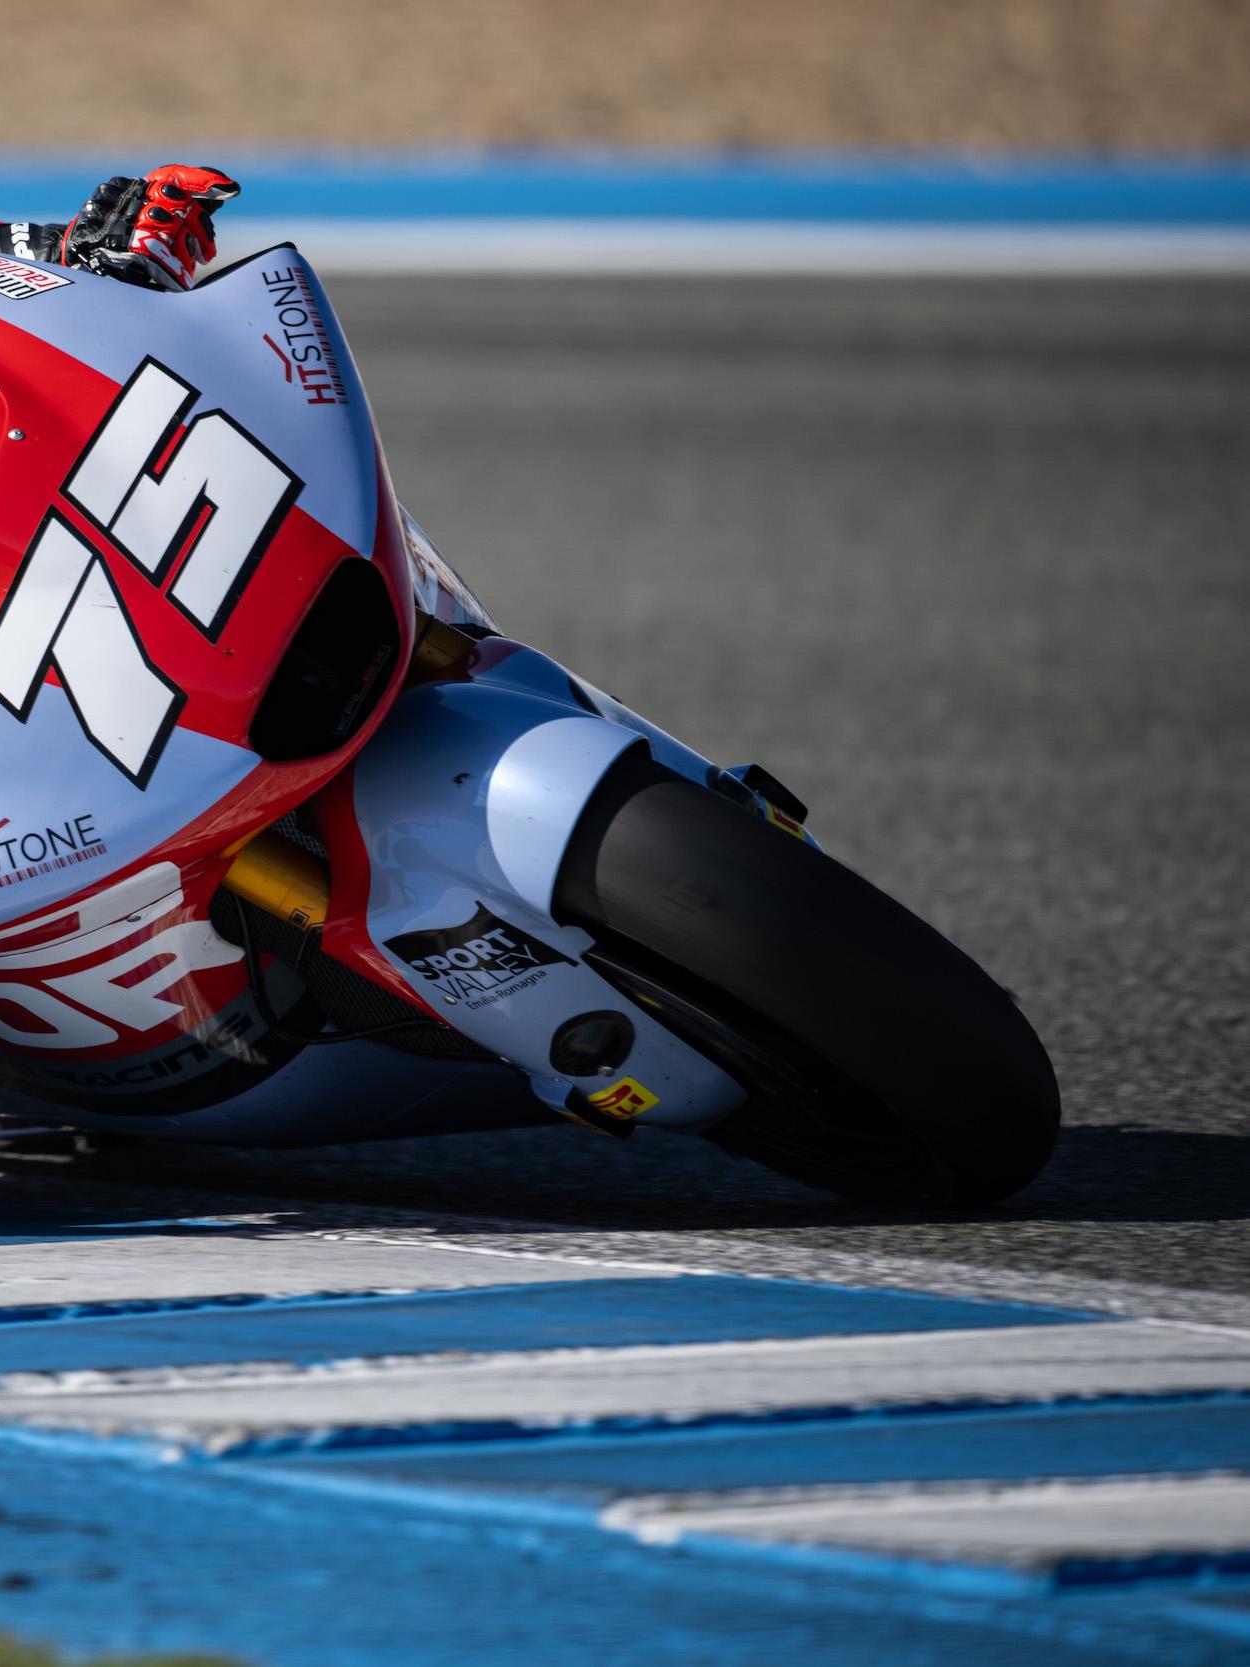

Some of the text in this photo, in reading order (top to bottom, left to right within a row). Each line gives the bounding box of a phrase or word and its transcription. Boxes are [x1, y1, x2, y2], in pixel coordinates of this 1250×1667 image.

[261, 266, 337, 405] HTSTONE
[410, 927, 517, 981] SPORT
[432, 943, 541, 1000] VALLEY
[465, 969, 548, 1011] Emilia-Romagna
